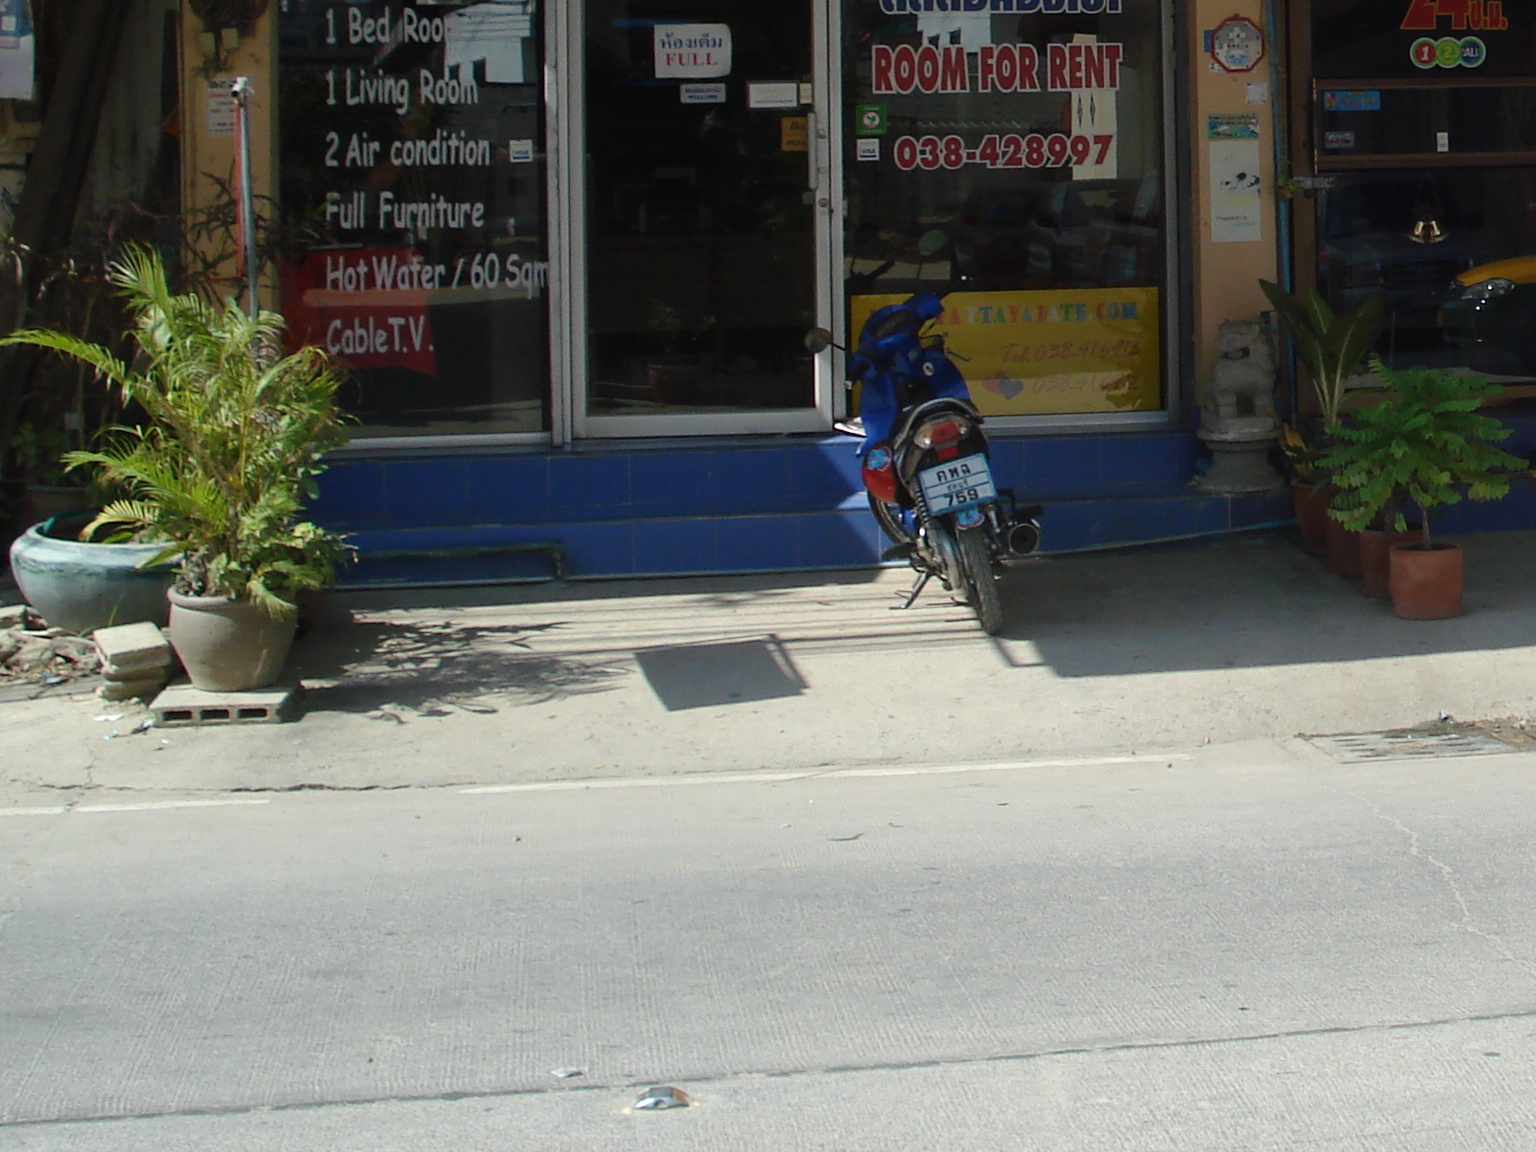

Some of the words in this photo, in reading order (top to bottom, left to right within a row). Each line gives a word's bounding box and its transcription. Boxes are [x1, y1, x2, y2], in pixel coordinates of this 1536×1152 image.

[325, 8, 337, 45] 1
[349, 6, 390, 45] Bed
[403, 7, 452, 43] Roo
[659, 32, 722, 50] ห้องเต็ม
[665, 52, 718, 67] FULL
[872, 45, 969, 93] ROOM
[978, 43, 1040, 92] FOR
[1048, 43, 1122, 92] RENT
[325, 69, 337, 106] 1
[345, 69, 409, 115] Living
[420, 69, 478, 105] Room
[325, 131, 340, 167] 2
[345, 131, 380, 167] Air
[390, 129, 490, 167] condition
[894, 134, 1113, 170] 038-428997
[325, 191, 365, 230] Full
[379, 191, 485, 230] Furniture
[326, 255, 368, 292] Hot
[372, 255, 446, 292] Water
[470, 253, 499, 290] 60
[326, 315, 388, 355] Cable
[944, 487, 979, 507] 759
